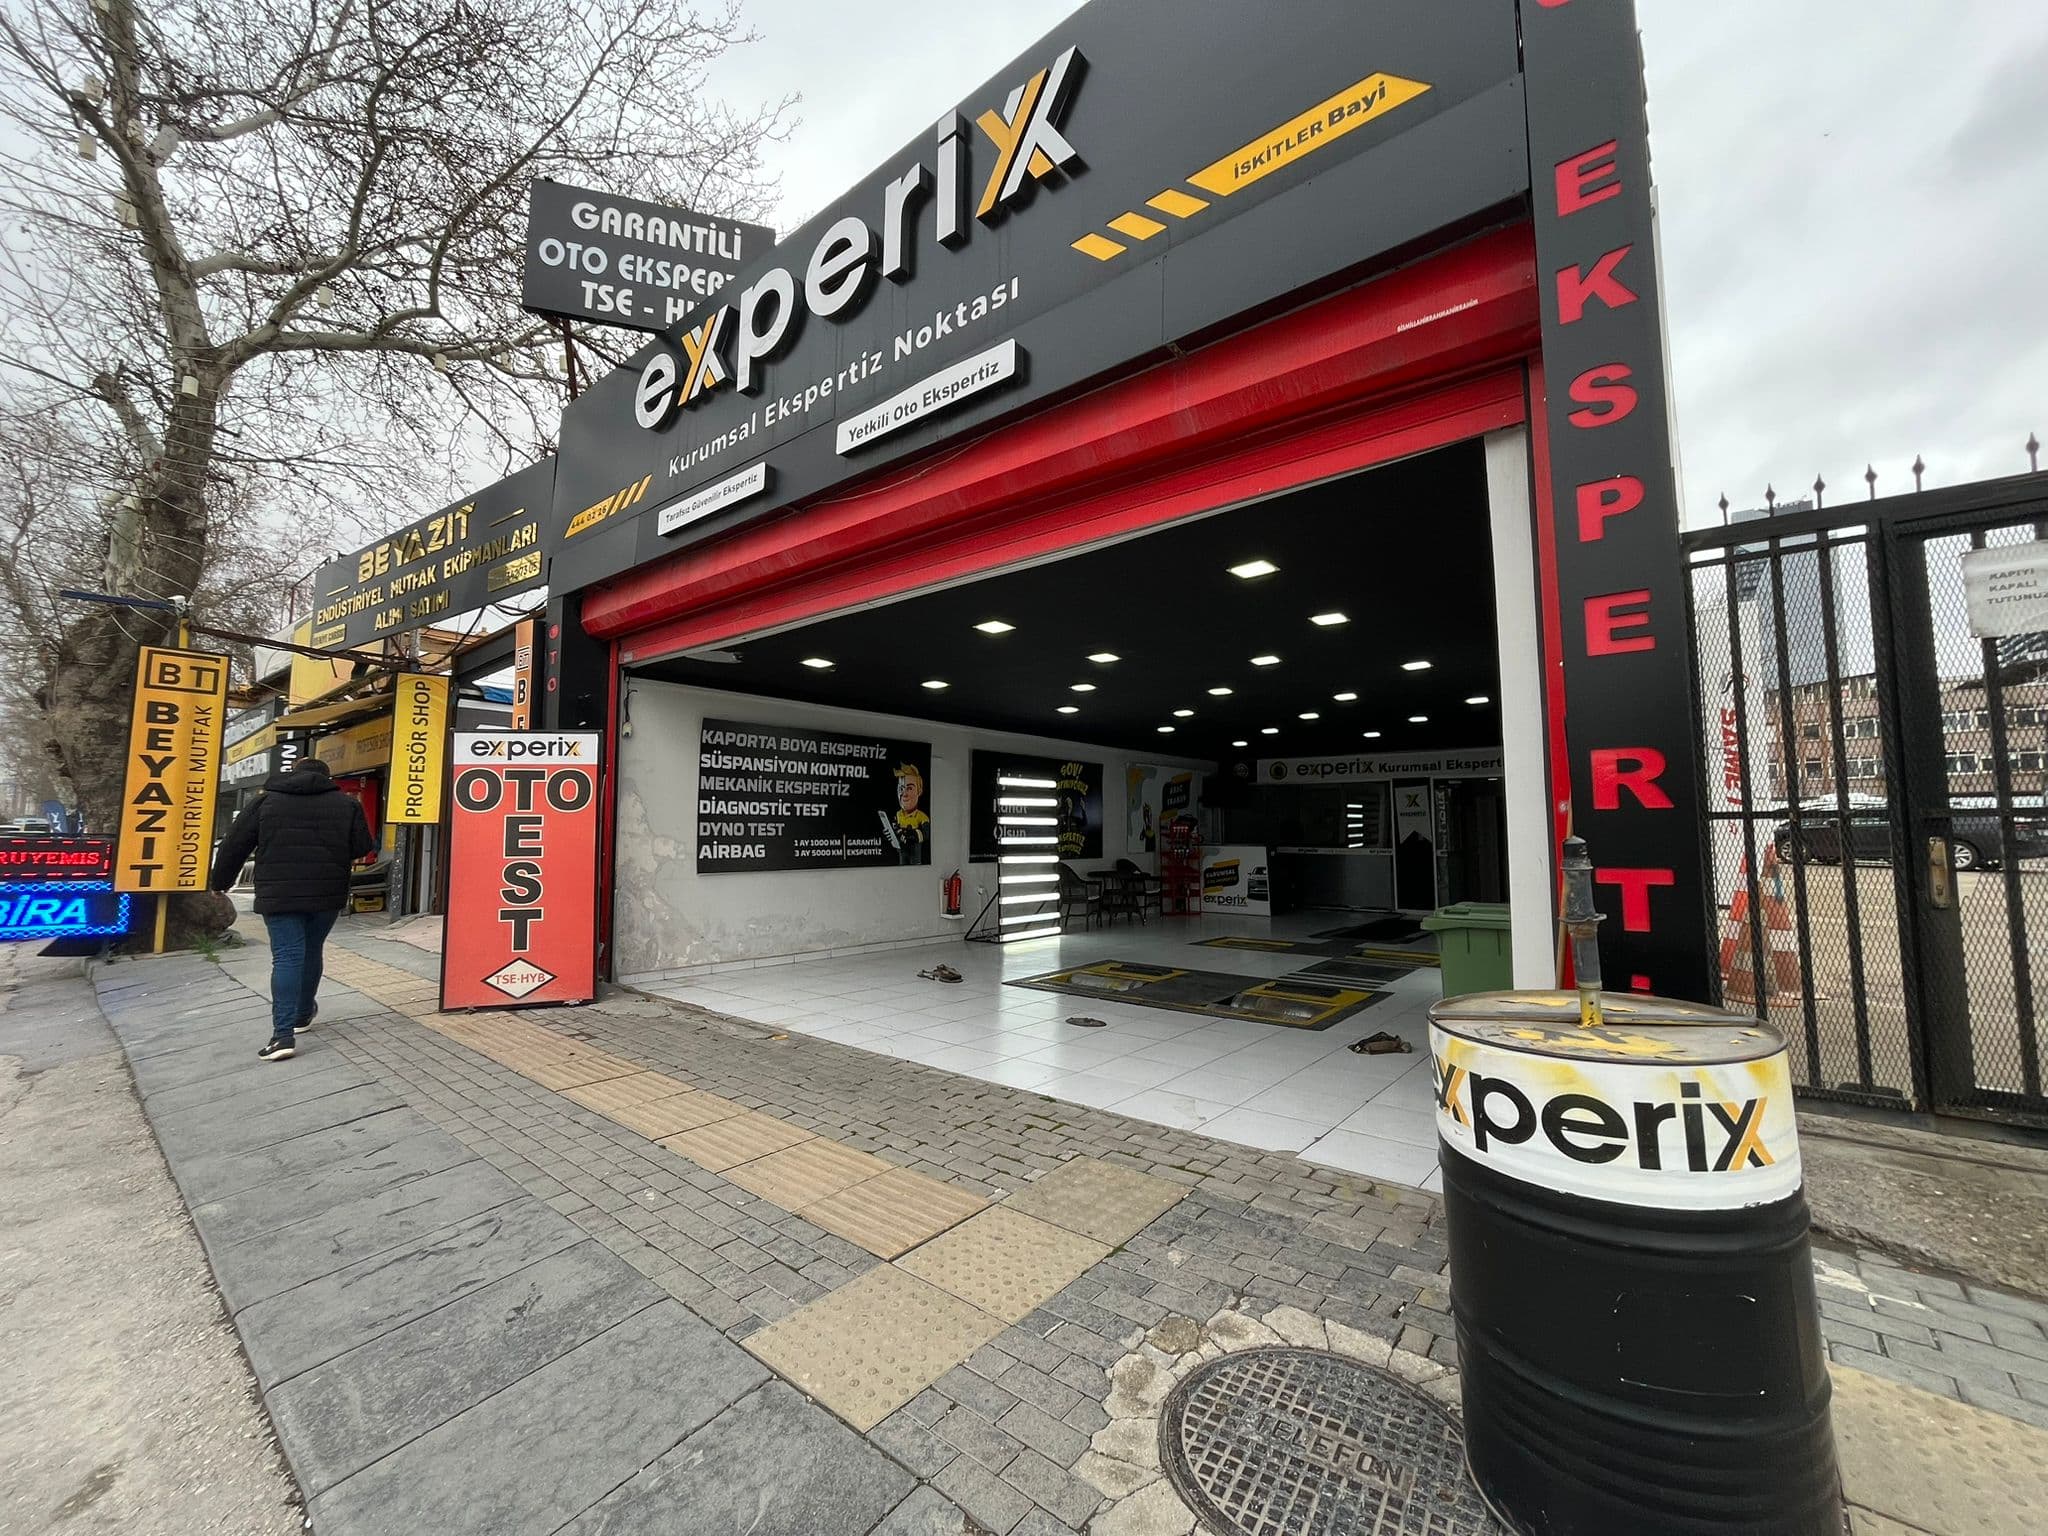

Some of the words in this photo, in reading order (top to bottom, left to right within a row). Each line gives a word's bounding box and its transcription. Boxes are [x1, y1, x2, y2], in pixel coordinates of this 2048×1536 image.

[1233, 121, 1324, 180] İSKİTLER
[1328, 80, 1387, 128] Bayi
[571, 201, 742, 261] GARANTİLİ
[634, 44, 1083, 430] experix
[538, 238, 608, 275] OTO
[618, 253, 736, 297] EKSPER
[581, 280, 633, 316] TSE
[668, 410, 757, 478] Kurumsal
[765, 352, 882, 428] Ekspertiz
[893, 275, 1020, 362] Noktası
[847, 413, 891, 442] Yetkili
[893, 400, 919, 426] Oto
[922, 358, 1000, 414] Ekspertiz
[722, 473, 758, 497] Ekspertiz
[358, 502, 476, 583] BEYAZIT
[390, 565, 437, 599] MUTFAK
[443, 522, 538, 579] EKİPMANLARI
[1553, 139, 1675, 992] EKSPERT
[1989, 580, 2037, 592] KAPALI
[412, 680, 431, 727] SHOP
[188, 705, 213, 773] MUTFAK
[470, 736, 582, 760] experix
[700, 750, 808, 775] SÜSPANSİYON
[810, 762, 870, 779] KONTROL
[701, 729, 777, 750] KAPORTA
[779, 738, 818, 754] BOYA
[820, 743, 887, 760] EKSPERTİZ
[129, 700, 180, 888] BEYAZIT
[404, 731, 428, 817] PROFESÖR
[453, 767, 593, 813] OTO
[700, 775, 772, 793] MEKANİK
[775, 779, 850, 796] EKSPERTİZ
[1296, 758, 1374, 778] experix
[1378, 760, 1441, 773] Kurumsal
[176, 778, 206, 888] ENDÜSTRİYEL
[699, 796, 791, 816] DİAGNOSTİC
[793, 803, 828, 817] TEST
[699, 822, 745, 837] DYNO
[747, 822, 785, 837] TEST
[698, 840, 766, 860] AİRBAG
